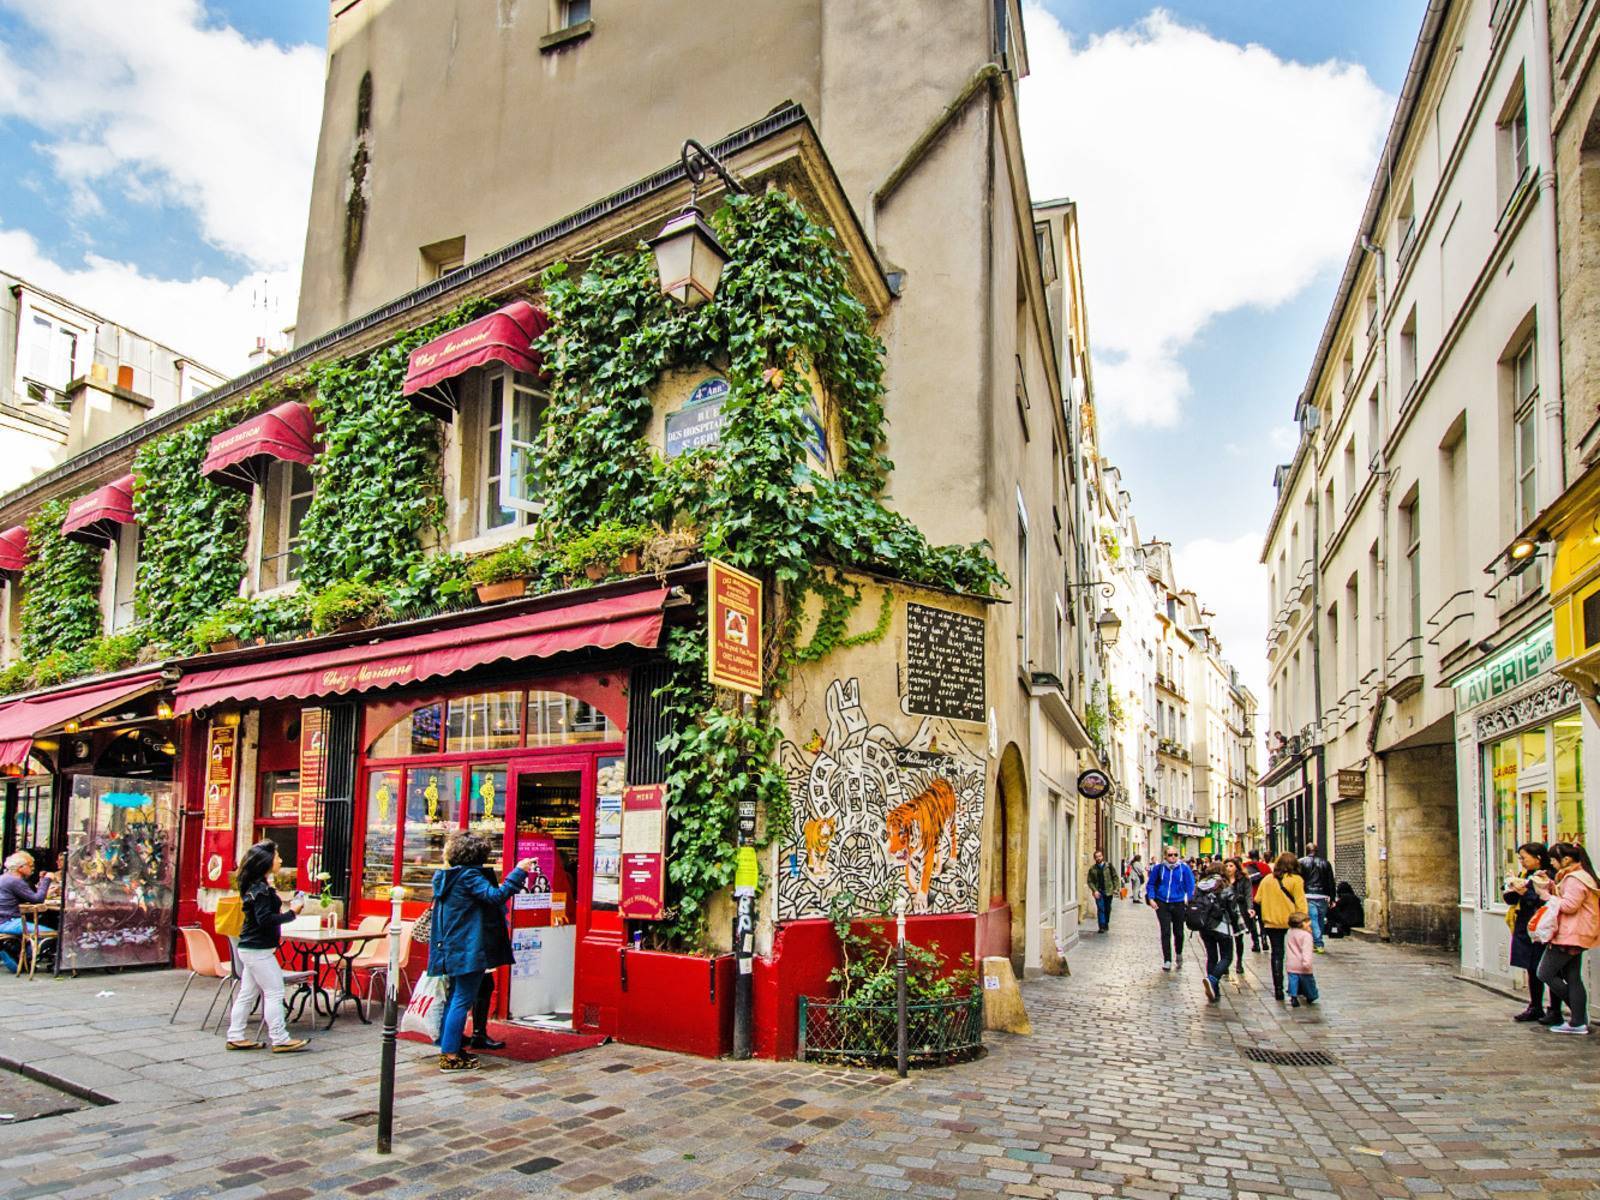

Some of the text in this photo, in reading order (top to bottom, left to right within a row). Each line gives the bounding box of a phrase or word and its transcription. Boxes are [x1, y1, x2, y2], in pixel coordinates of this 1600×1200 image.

[415, 331, 491, 368] Chez Marianne
[698, 408, 720, 422] RUE
[668, 431, 682, 442] DES
[322, 664, 413, 690] Chez Marianne
[1458, 643, 1538, 710] LAVERIE
